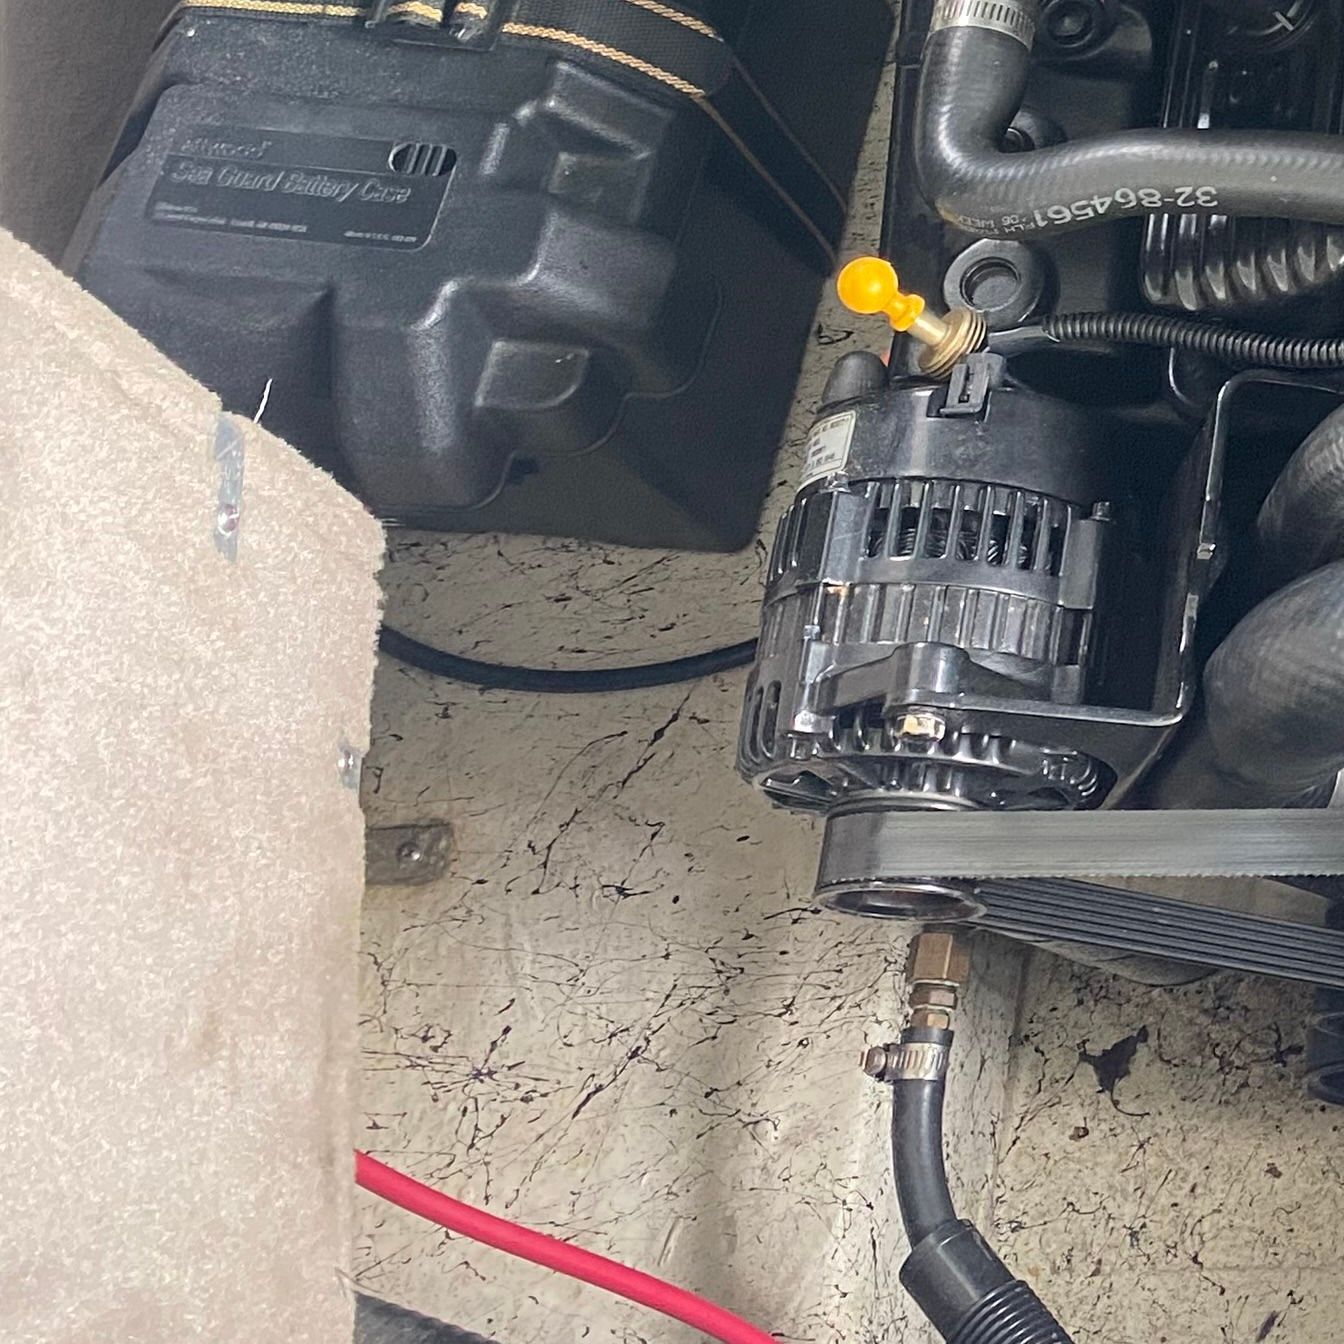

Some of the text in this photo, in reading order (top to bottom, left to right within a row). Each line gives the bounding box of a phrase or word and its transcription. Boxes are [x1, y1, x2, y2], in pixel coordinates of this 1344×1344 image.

[172, 161, 412, 204] Sea Guard Battery Case
[1033, 186, 1218, 228] 32-864561
